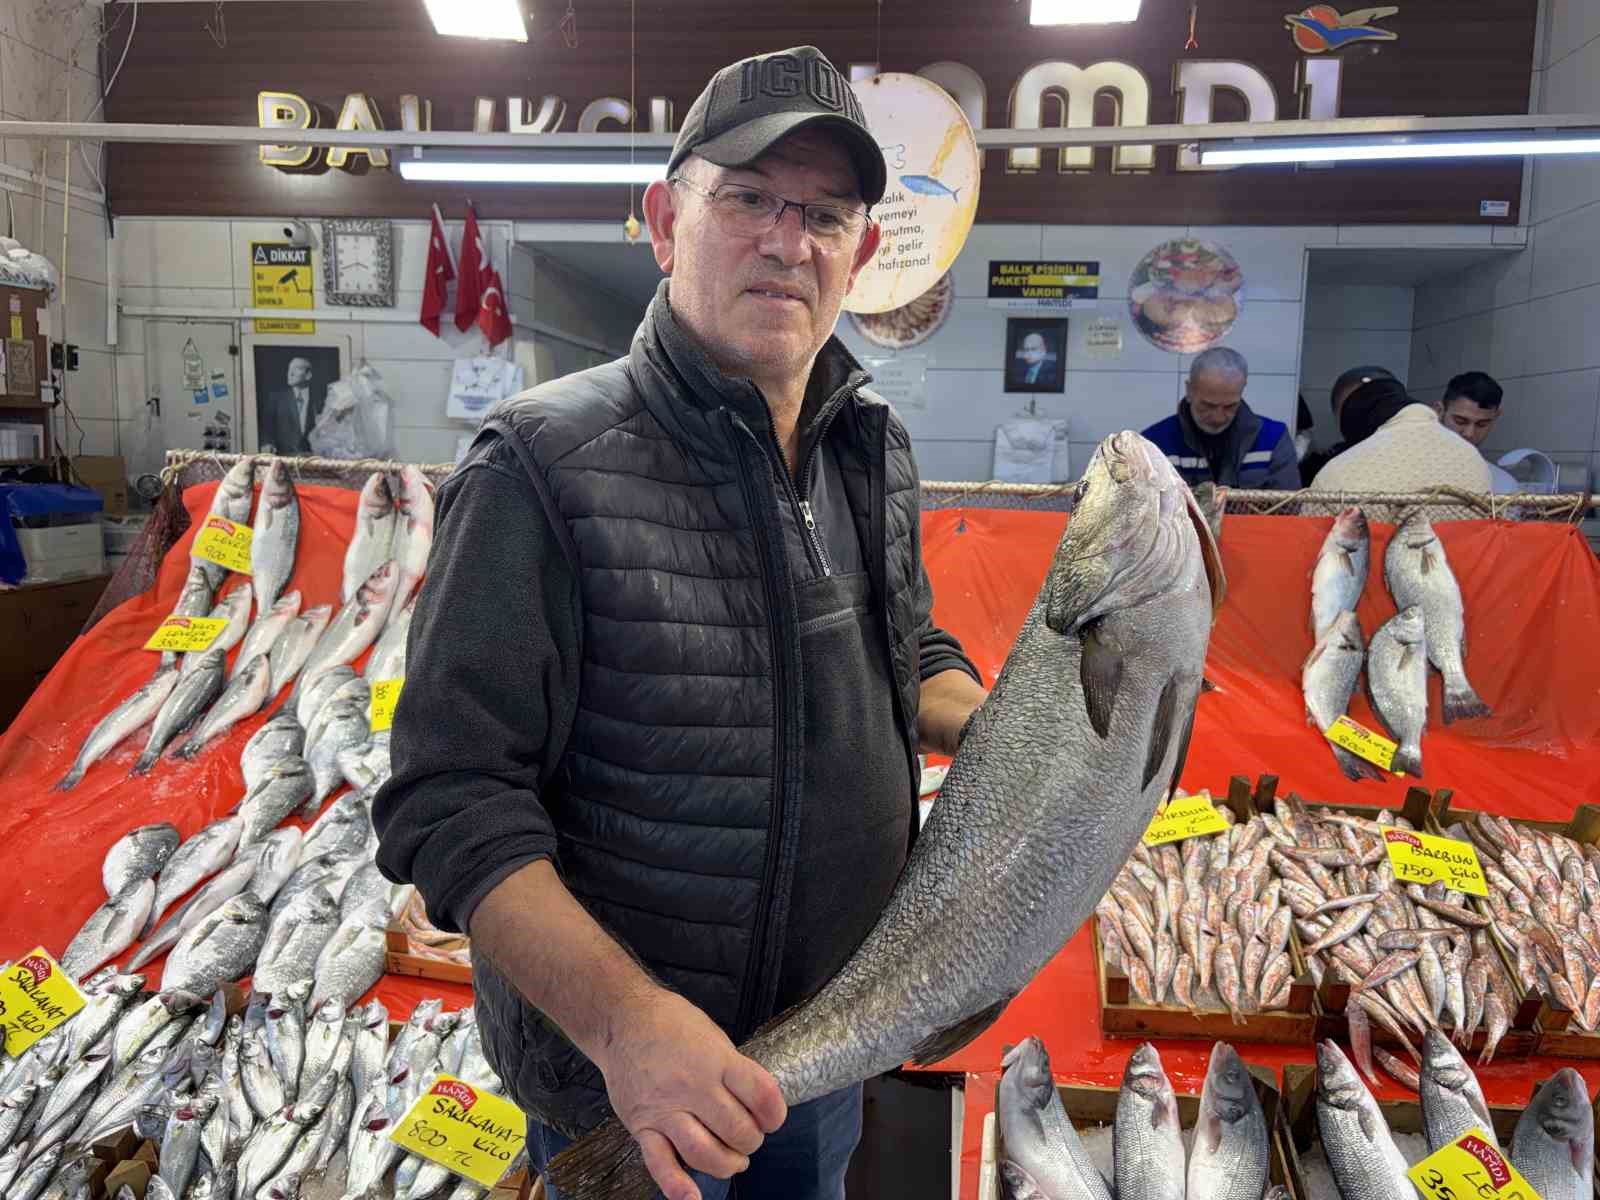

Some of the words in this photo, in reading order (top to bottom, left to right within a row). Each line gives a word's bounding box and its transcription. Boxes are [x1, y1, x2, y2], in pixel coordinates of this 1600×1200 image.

[878, 208, 917, 222] yemeyi
[897, 239, 924, 255] gelir
[270, 248, 306, 263] DİKKAT
[1000, 264, 1034, 274] BALIK
[992, 275, 1028, 286] PAKET
[1395, 862, 1434, 878] 750
[407, 1119, 448, 1147] 800
